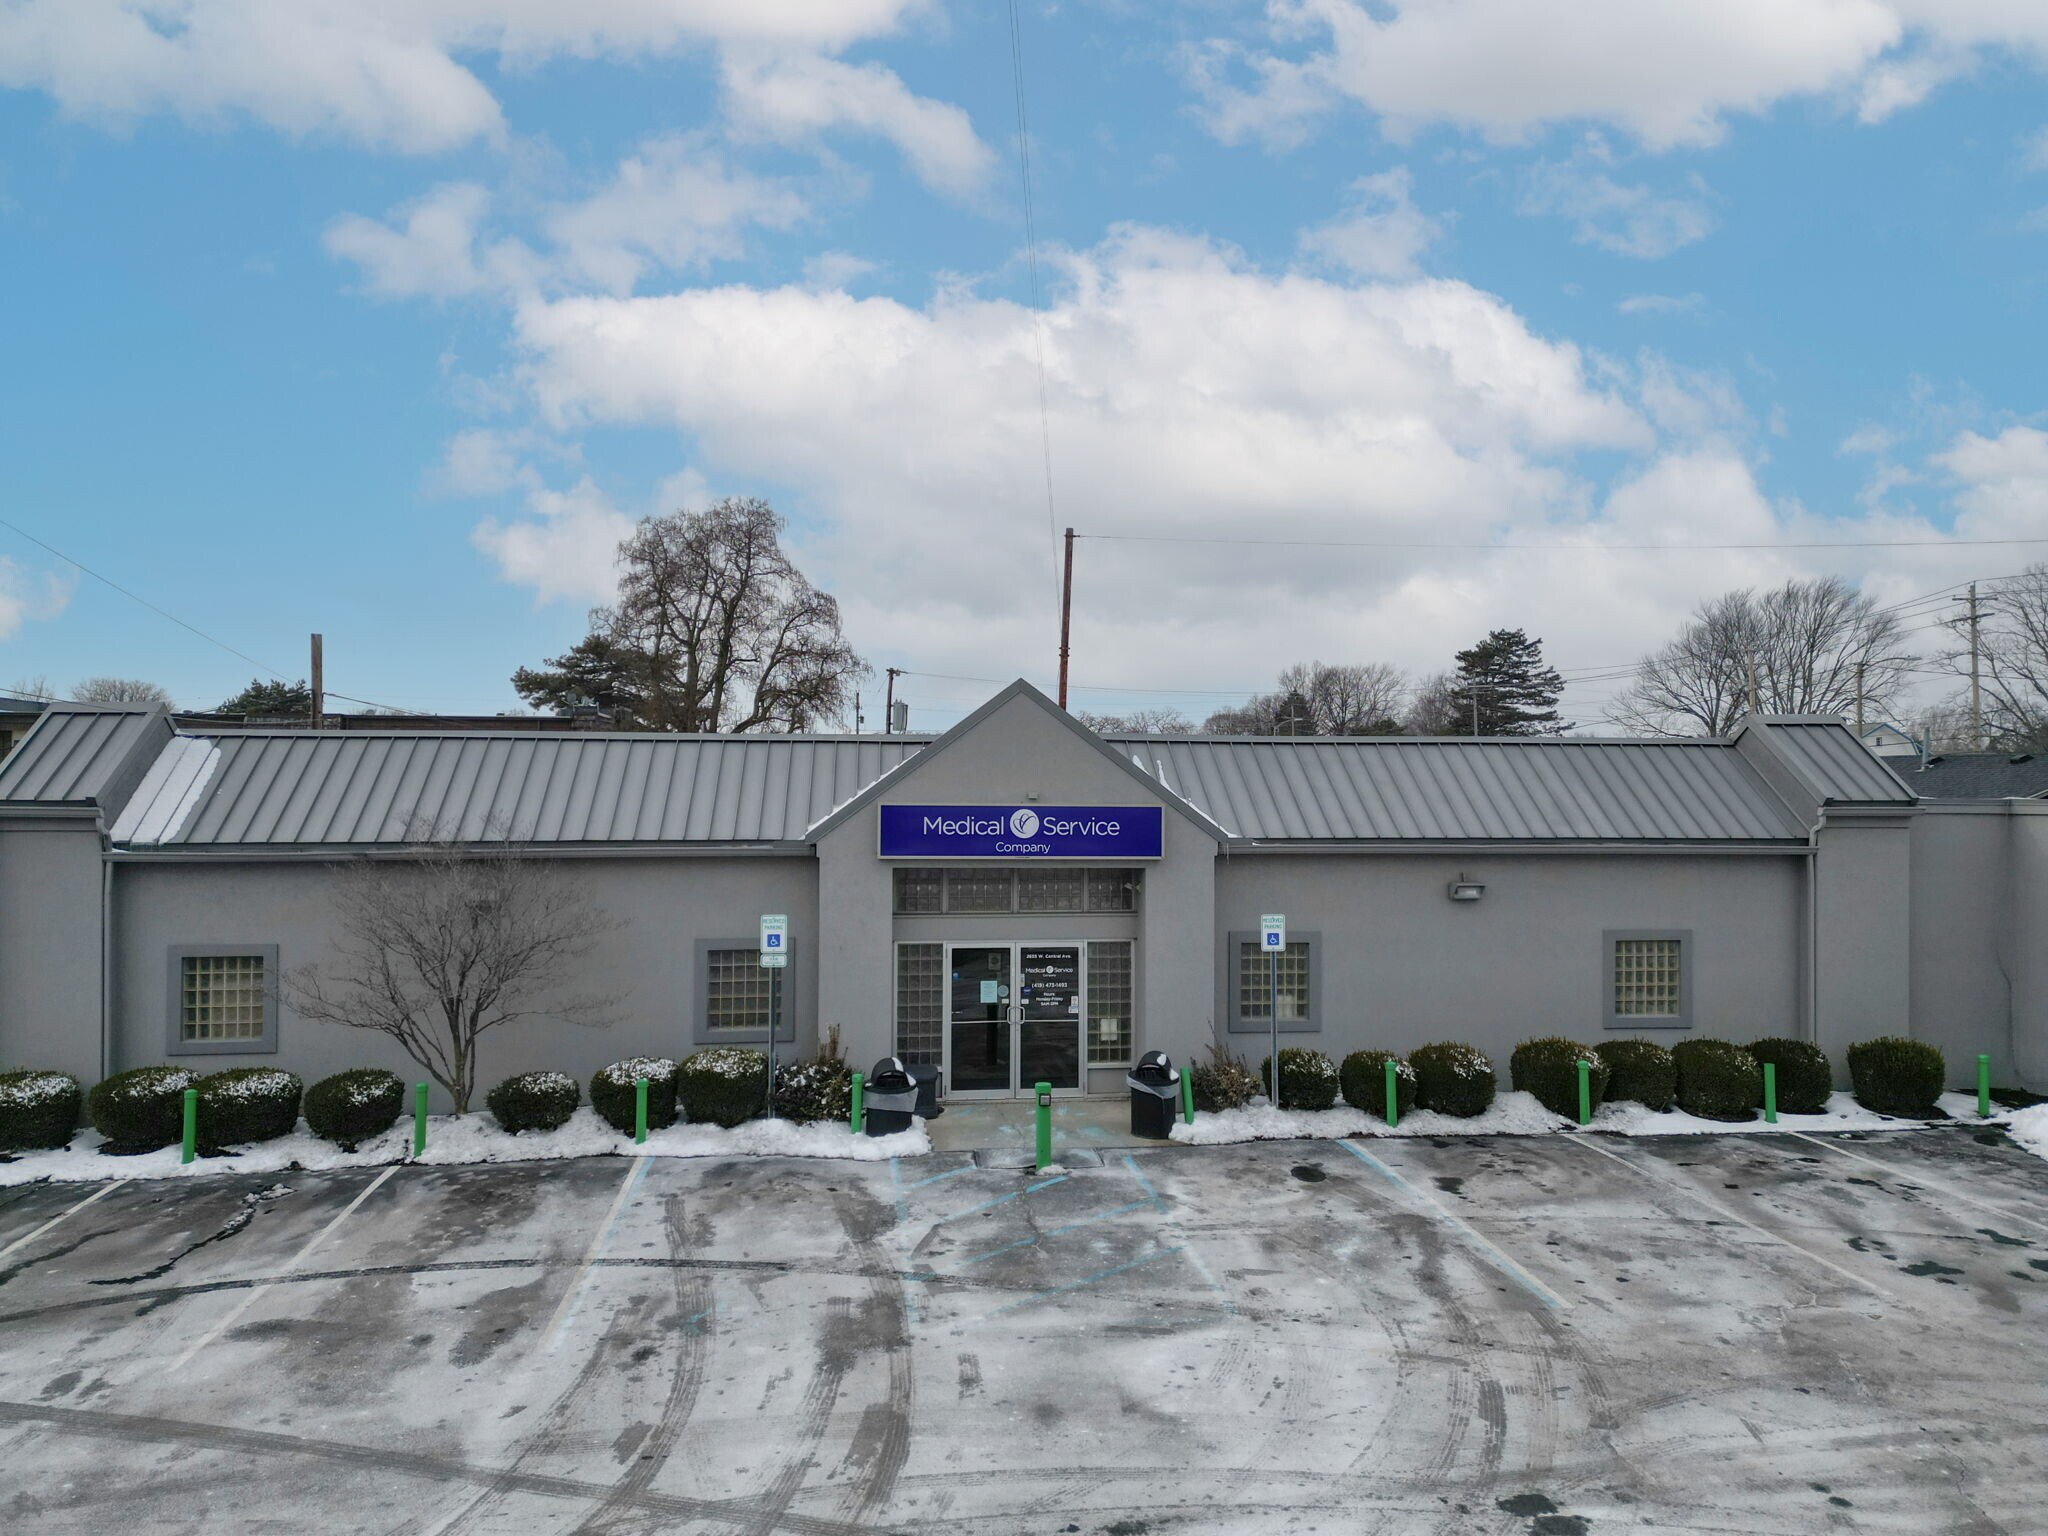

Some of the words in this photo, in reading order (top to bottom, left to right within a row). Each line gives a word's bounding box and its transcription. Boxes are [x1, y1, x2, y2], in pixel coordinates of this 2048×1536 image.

[923, 816, 1005, 836] Medical
[1043, 816, 1121, 836] Service
[995, 841, 1051, 854] Company
